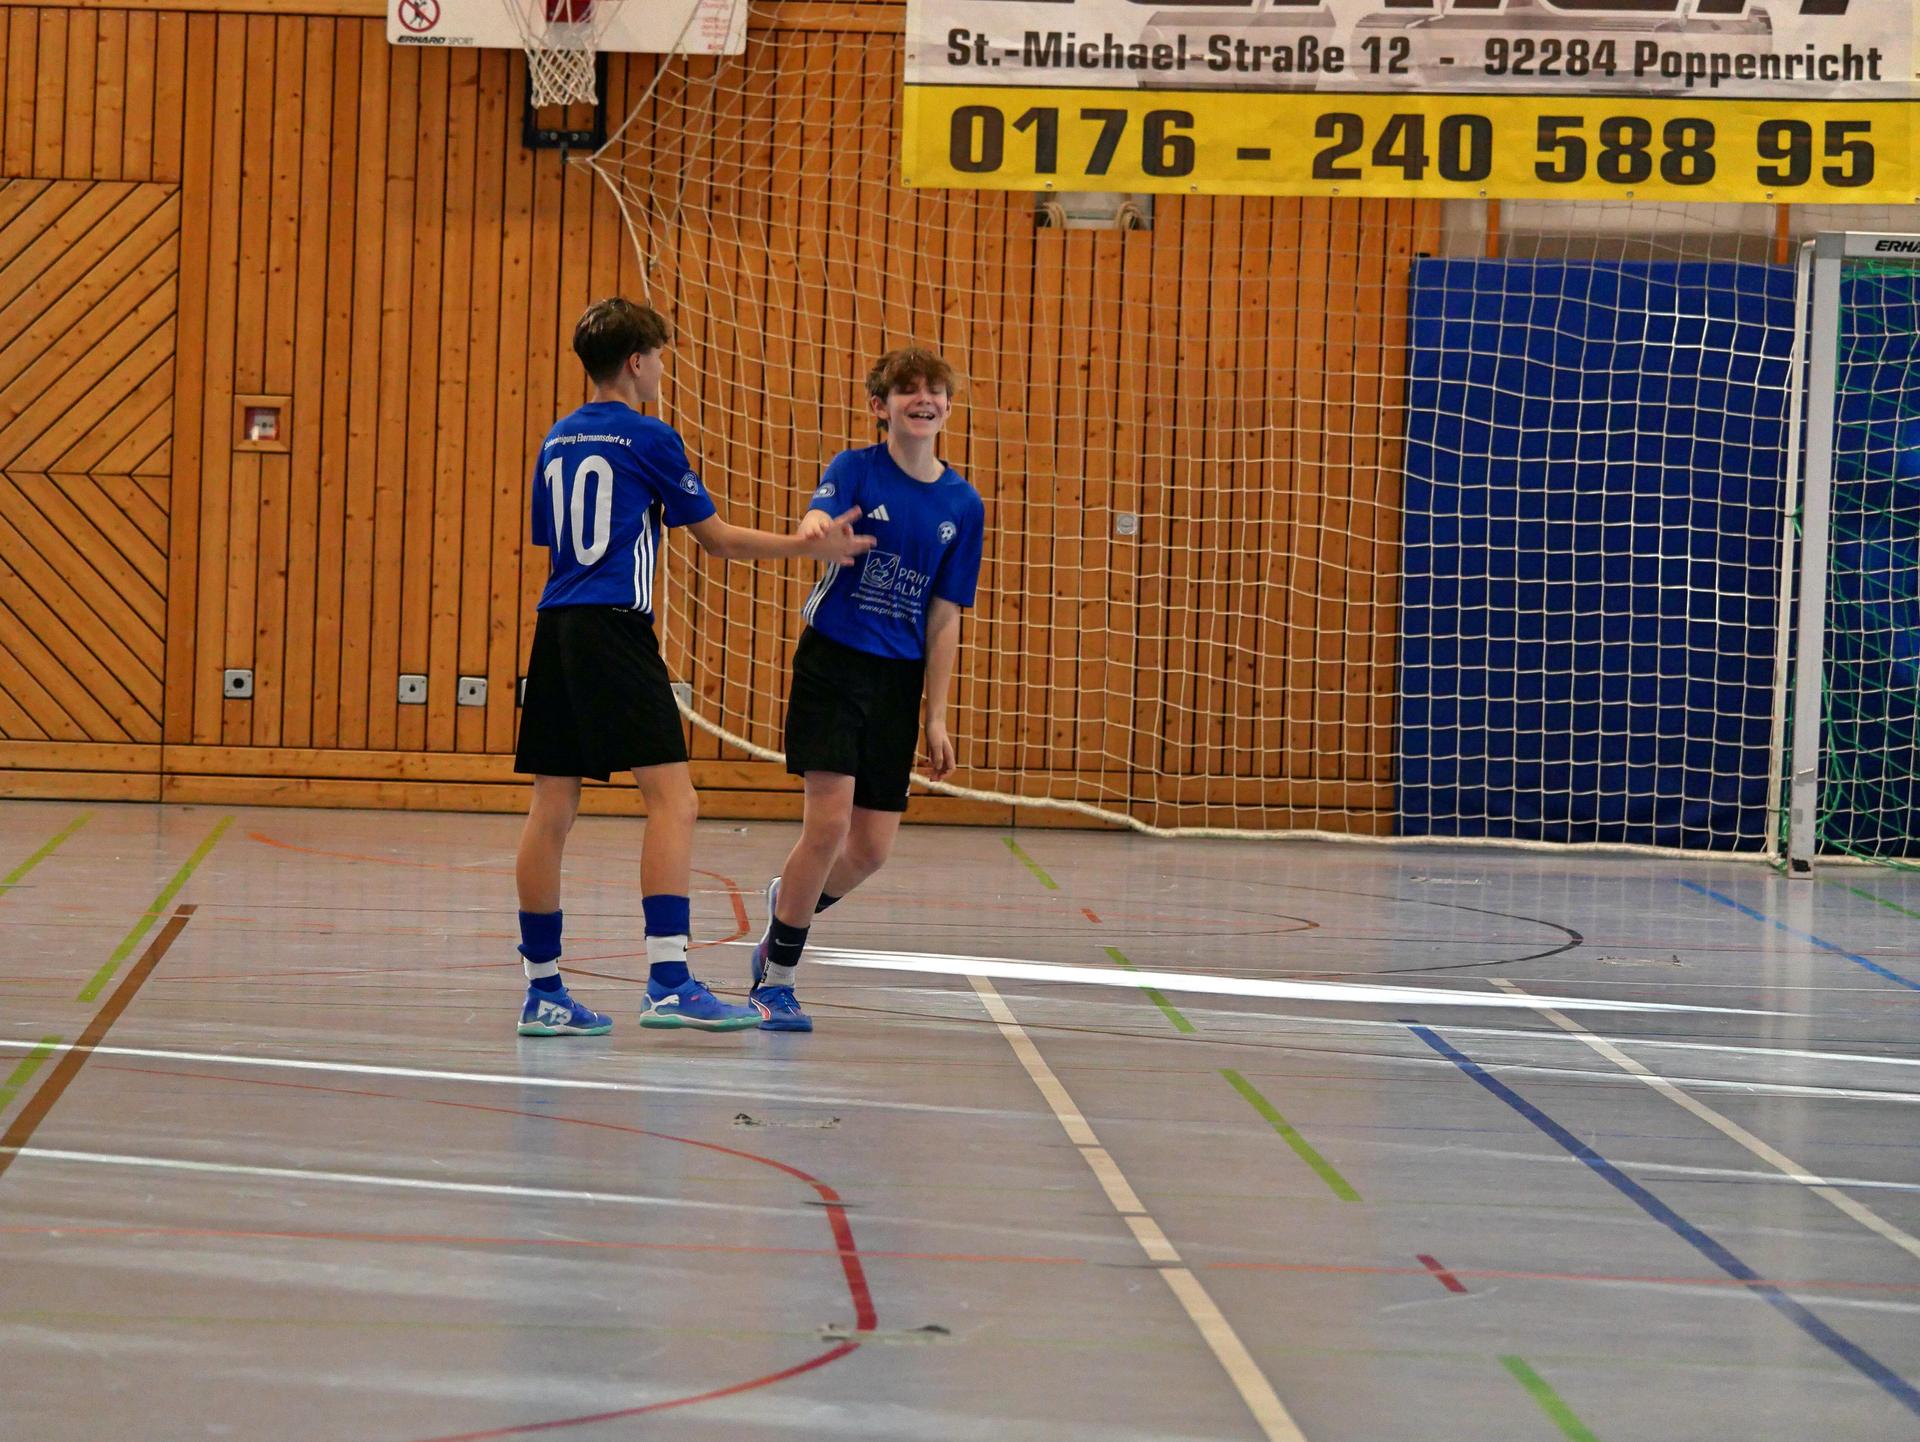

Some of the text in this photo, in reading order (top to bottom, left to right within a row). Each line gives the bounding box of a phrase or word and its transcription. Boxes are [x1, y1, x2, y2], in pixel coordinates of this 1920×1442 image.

[398, 36, 446, 44] ERHARD
[948, 28, 1882, 88] St.-Michael-Straße 12 - 92284 Poppenricht
[949, 105, 1875, 188] 0176 - 240 588 95
[544, 455, 613, 566] 10
[894, 582, 922, 598] ALM
